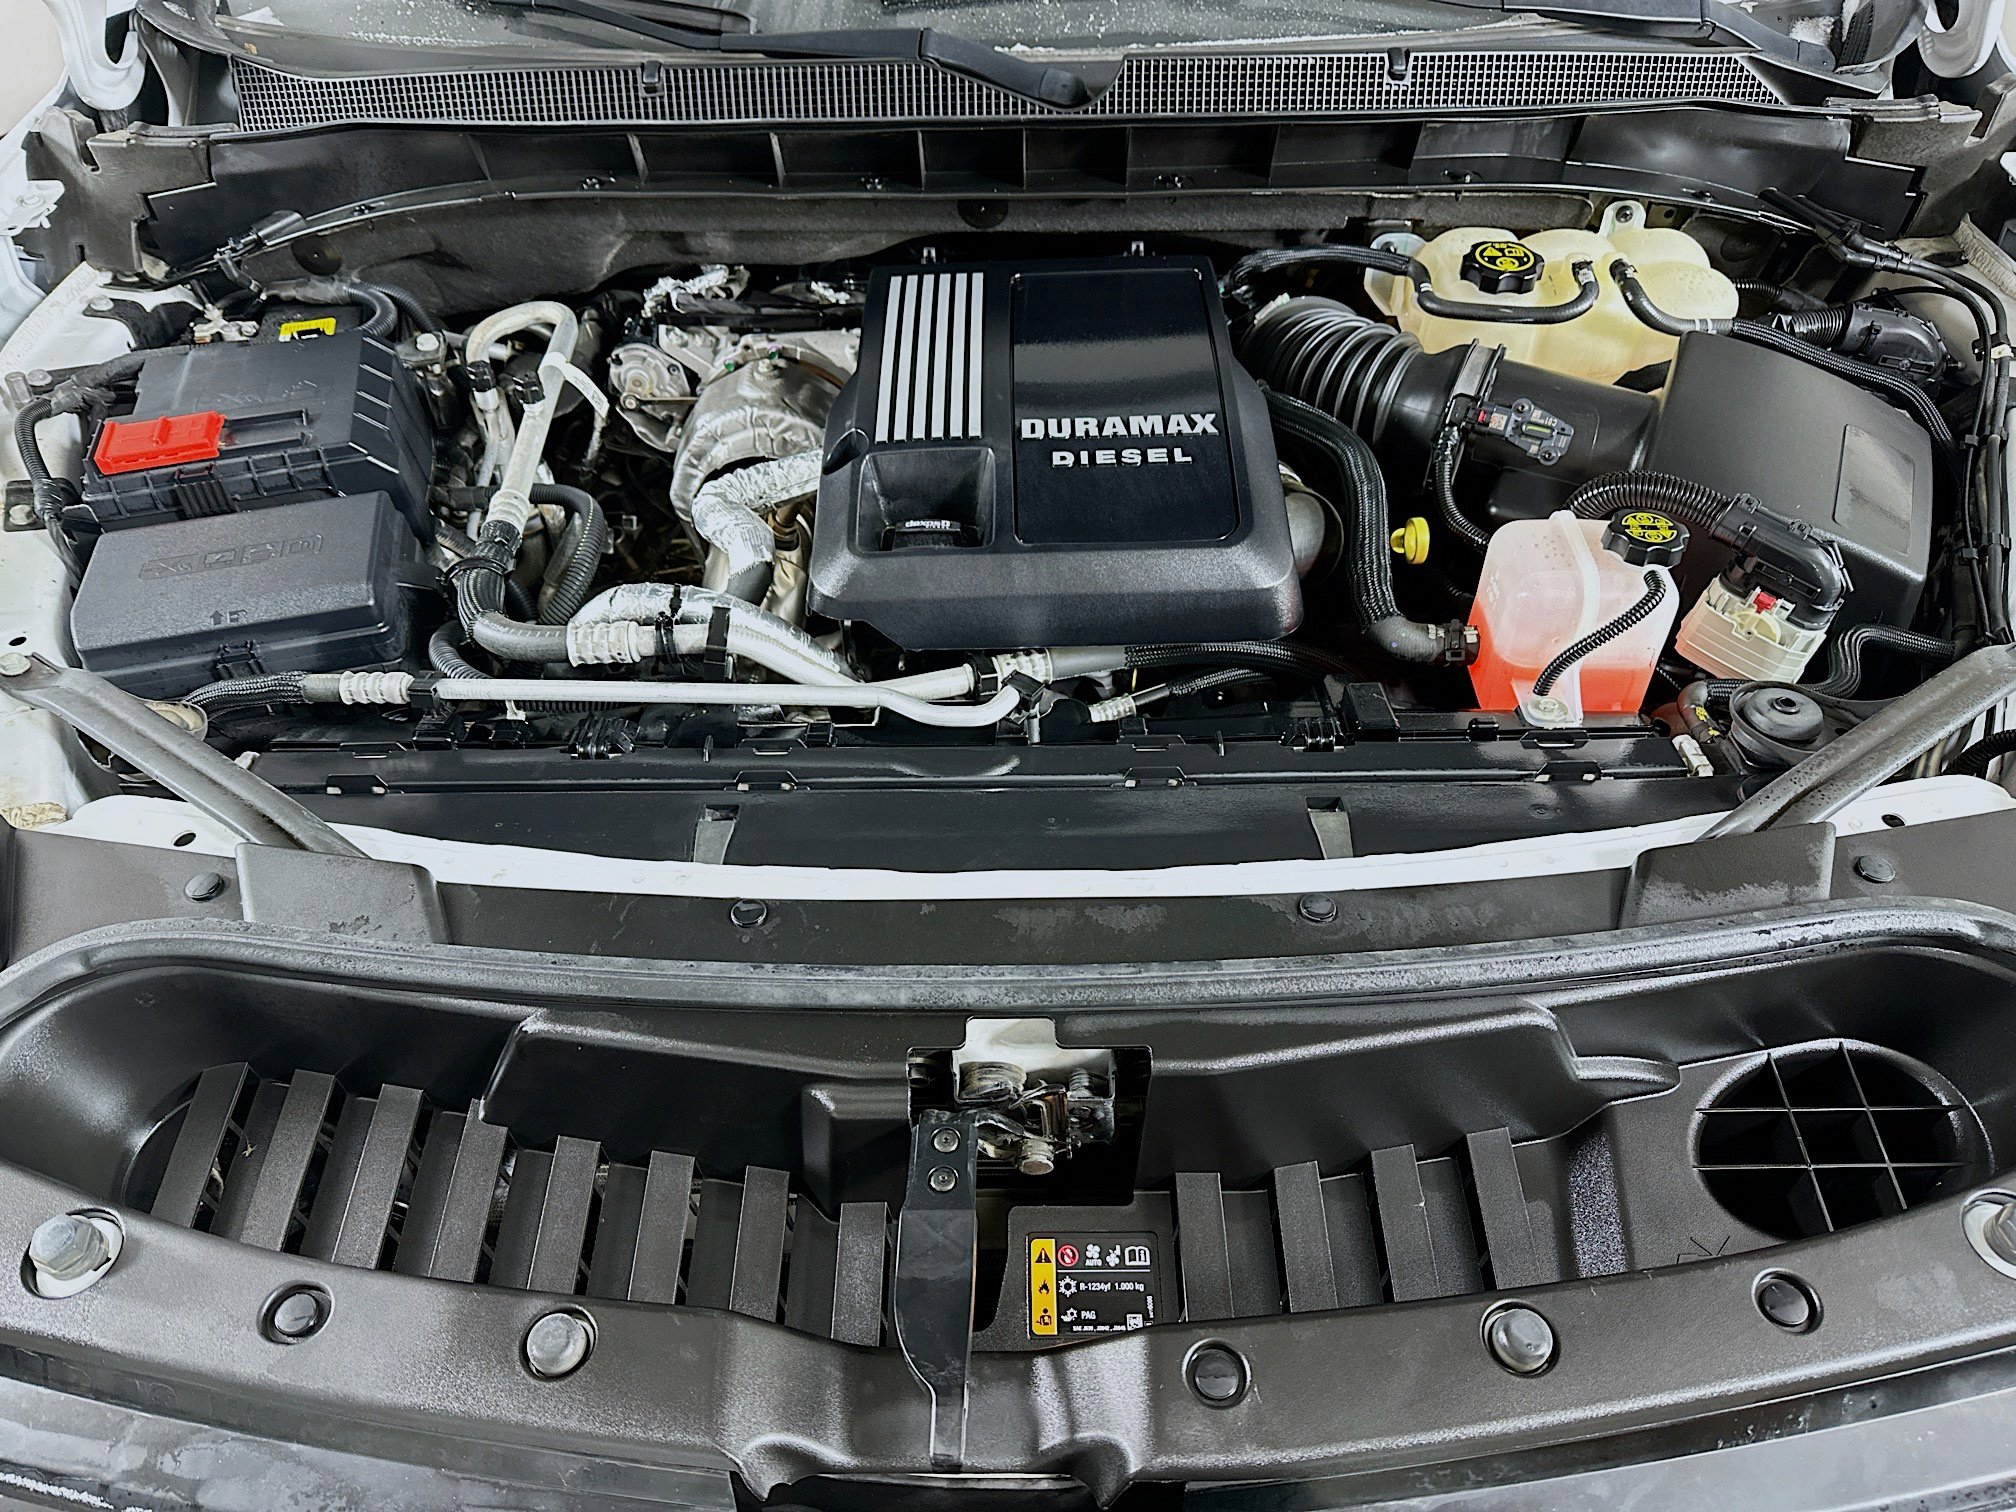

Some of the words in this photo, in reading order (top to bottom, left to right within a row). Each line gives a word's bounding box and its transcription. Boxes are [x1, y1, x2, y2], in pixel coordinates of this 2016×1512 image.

[1020, 413, 1219, 440] DURAMAX
[1052, 447, 1193, 467] DIESEL
[1085, 1258, 1102, 1267] AUTO
[1079, 1282, 1111, 1292] R-1234yf
[1115, 1282, 1134, 1291] 1.000
[1134, 1282, 1145, 1292] kg
[1081, 1311, 1096, 1320] PAG
